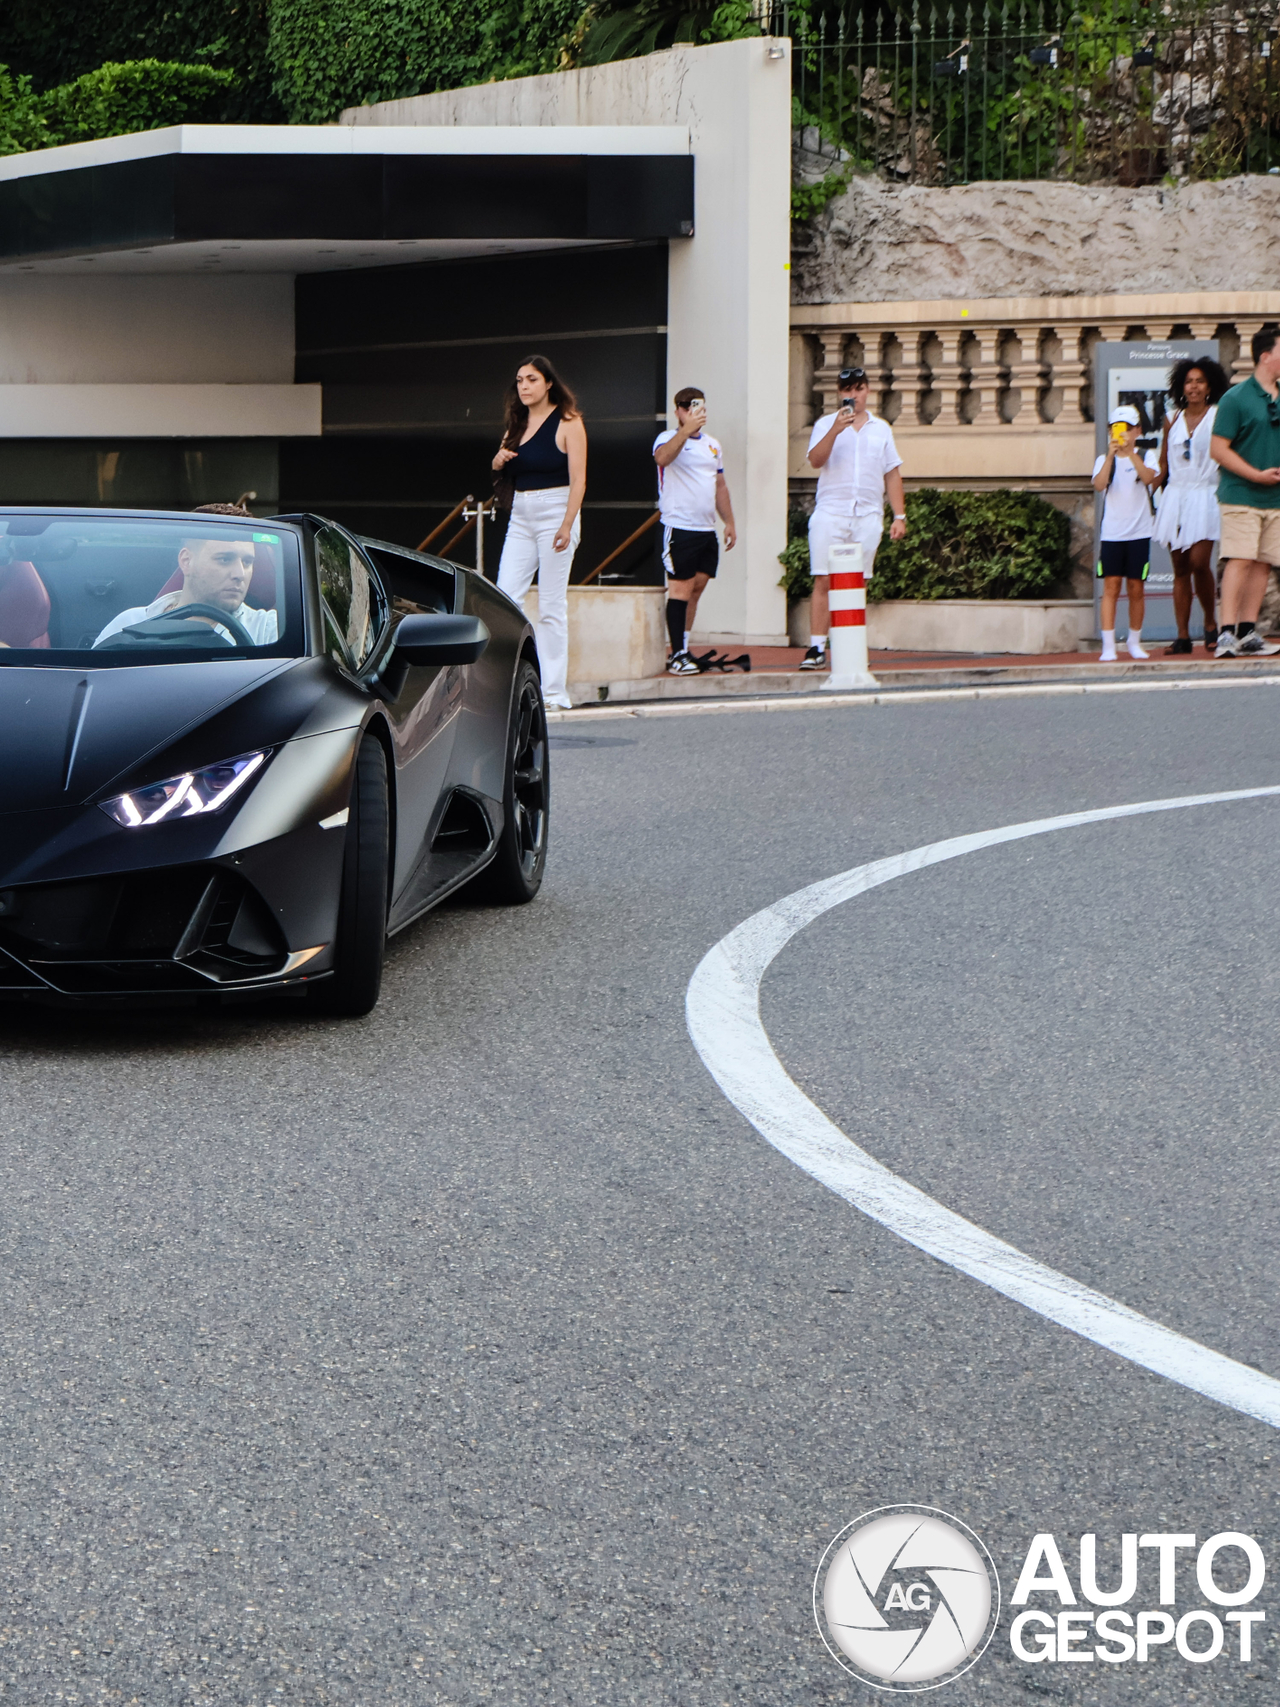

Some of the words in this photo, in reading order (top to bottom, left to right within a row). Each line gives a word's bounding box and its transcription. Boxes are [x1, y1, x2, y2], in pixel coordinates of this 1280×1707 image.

[1129, 350, 1165, 360] Princesse
[1166, 350, 1189, 360] Grace
[1146, 573, 1175, 582] onaco
